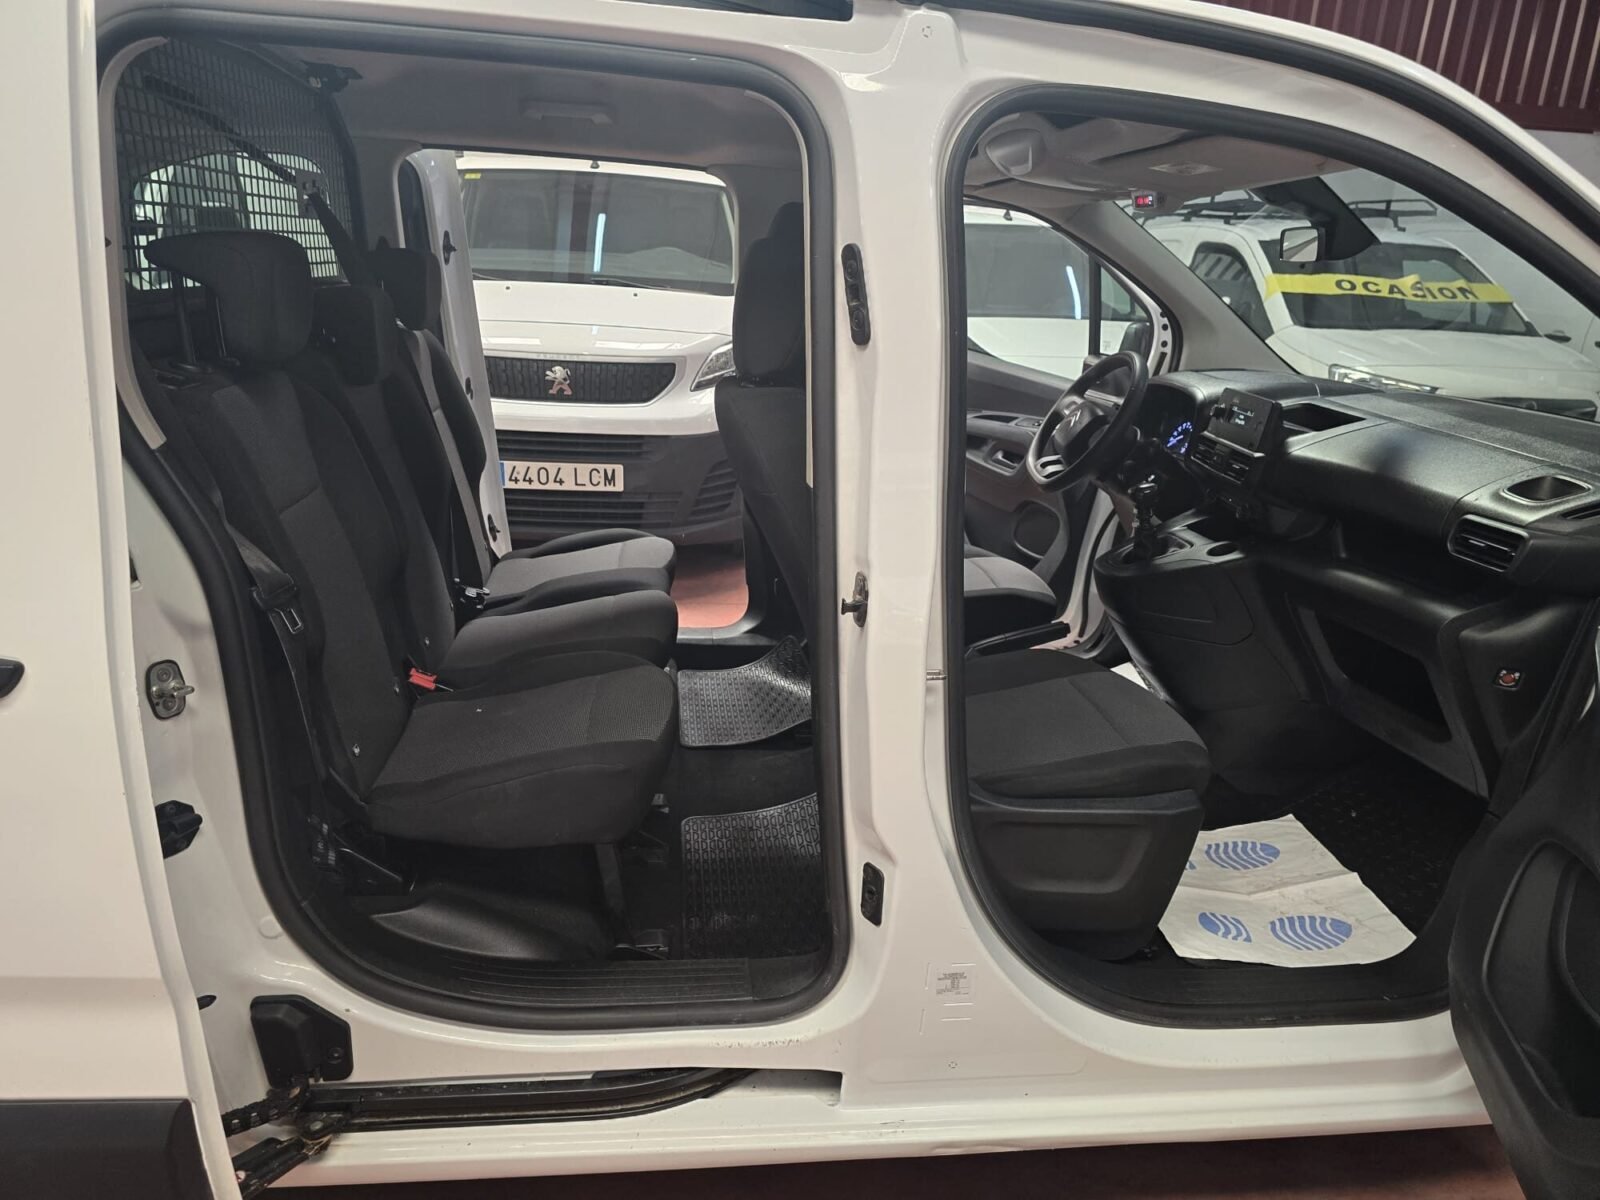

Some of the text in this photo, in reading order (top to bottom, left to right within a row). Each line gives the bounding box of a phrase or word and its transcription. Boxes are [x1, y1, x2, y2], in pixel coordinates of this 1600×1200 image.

[1335, 278, 1480, 300] OCASION
[508, 465, 616, 487] 4404 LCM
